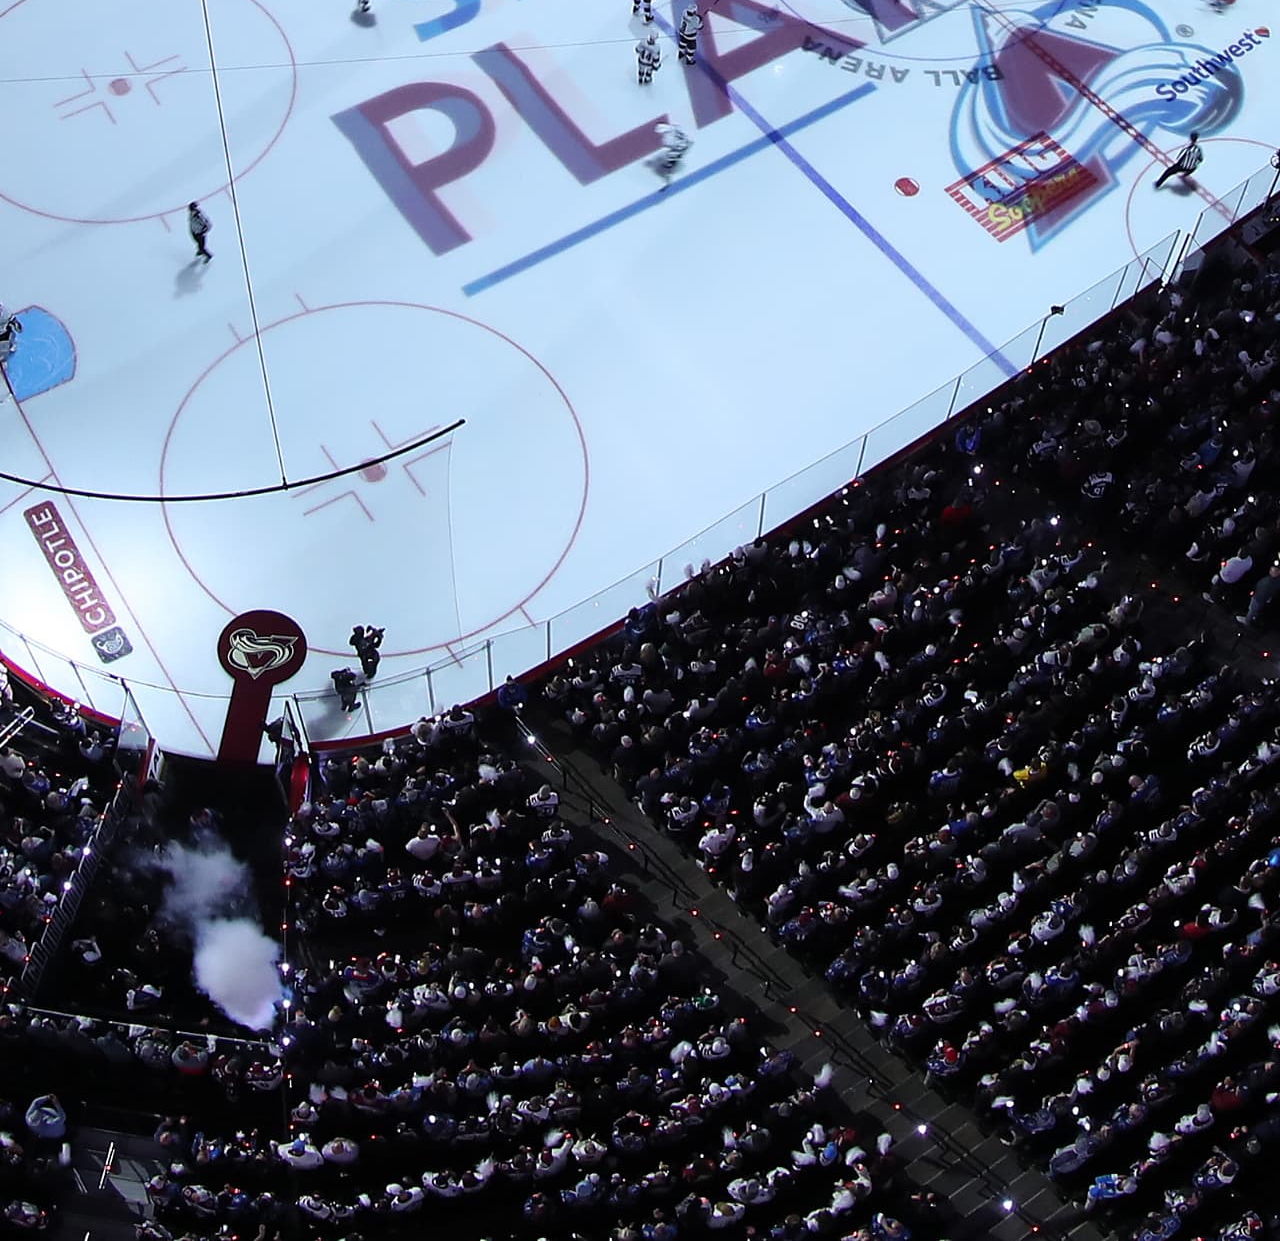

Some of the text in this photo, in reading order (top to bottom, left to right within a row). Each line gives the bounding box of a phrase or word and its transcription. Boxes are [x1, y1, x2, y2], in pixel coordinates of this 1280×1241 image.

[801, 34, 1005, 88] BALL ARENA
[1155, 27, 1263, 103] Southwest
[955, 139, 1064, 209] KING
[31, 506, 108, 629] CHIPOTLE
